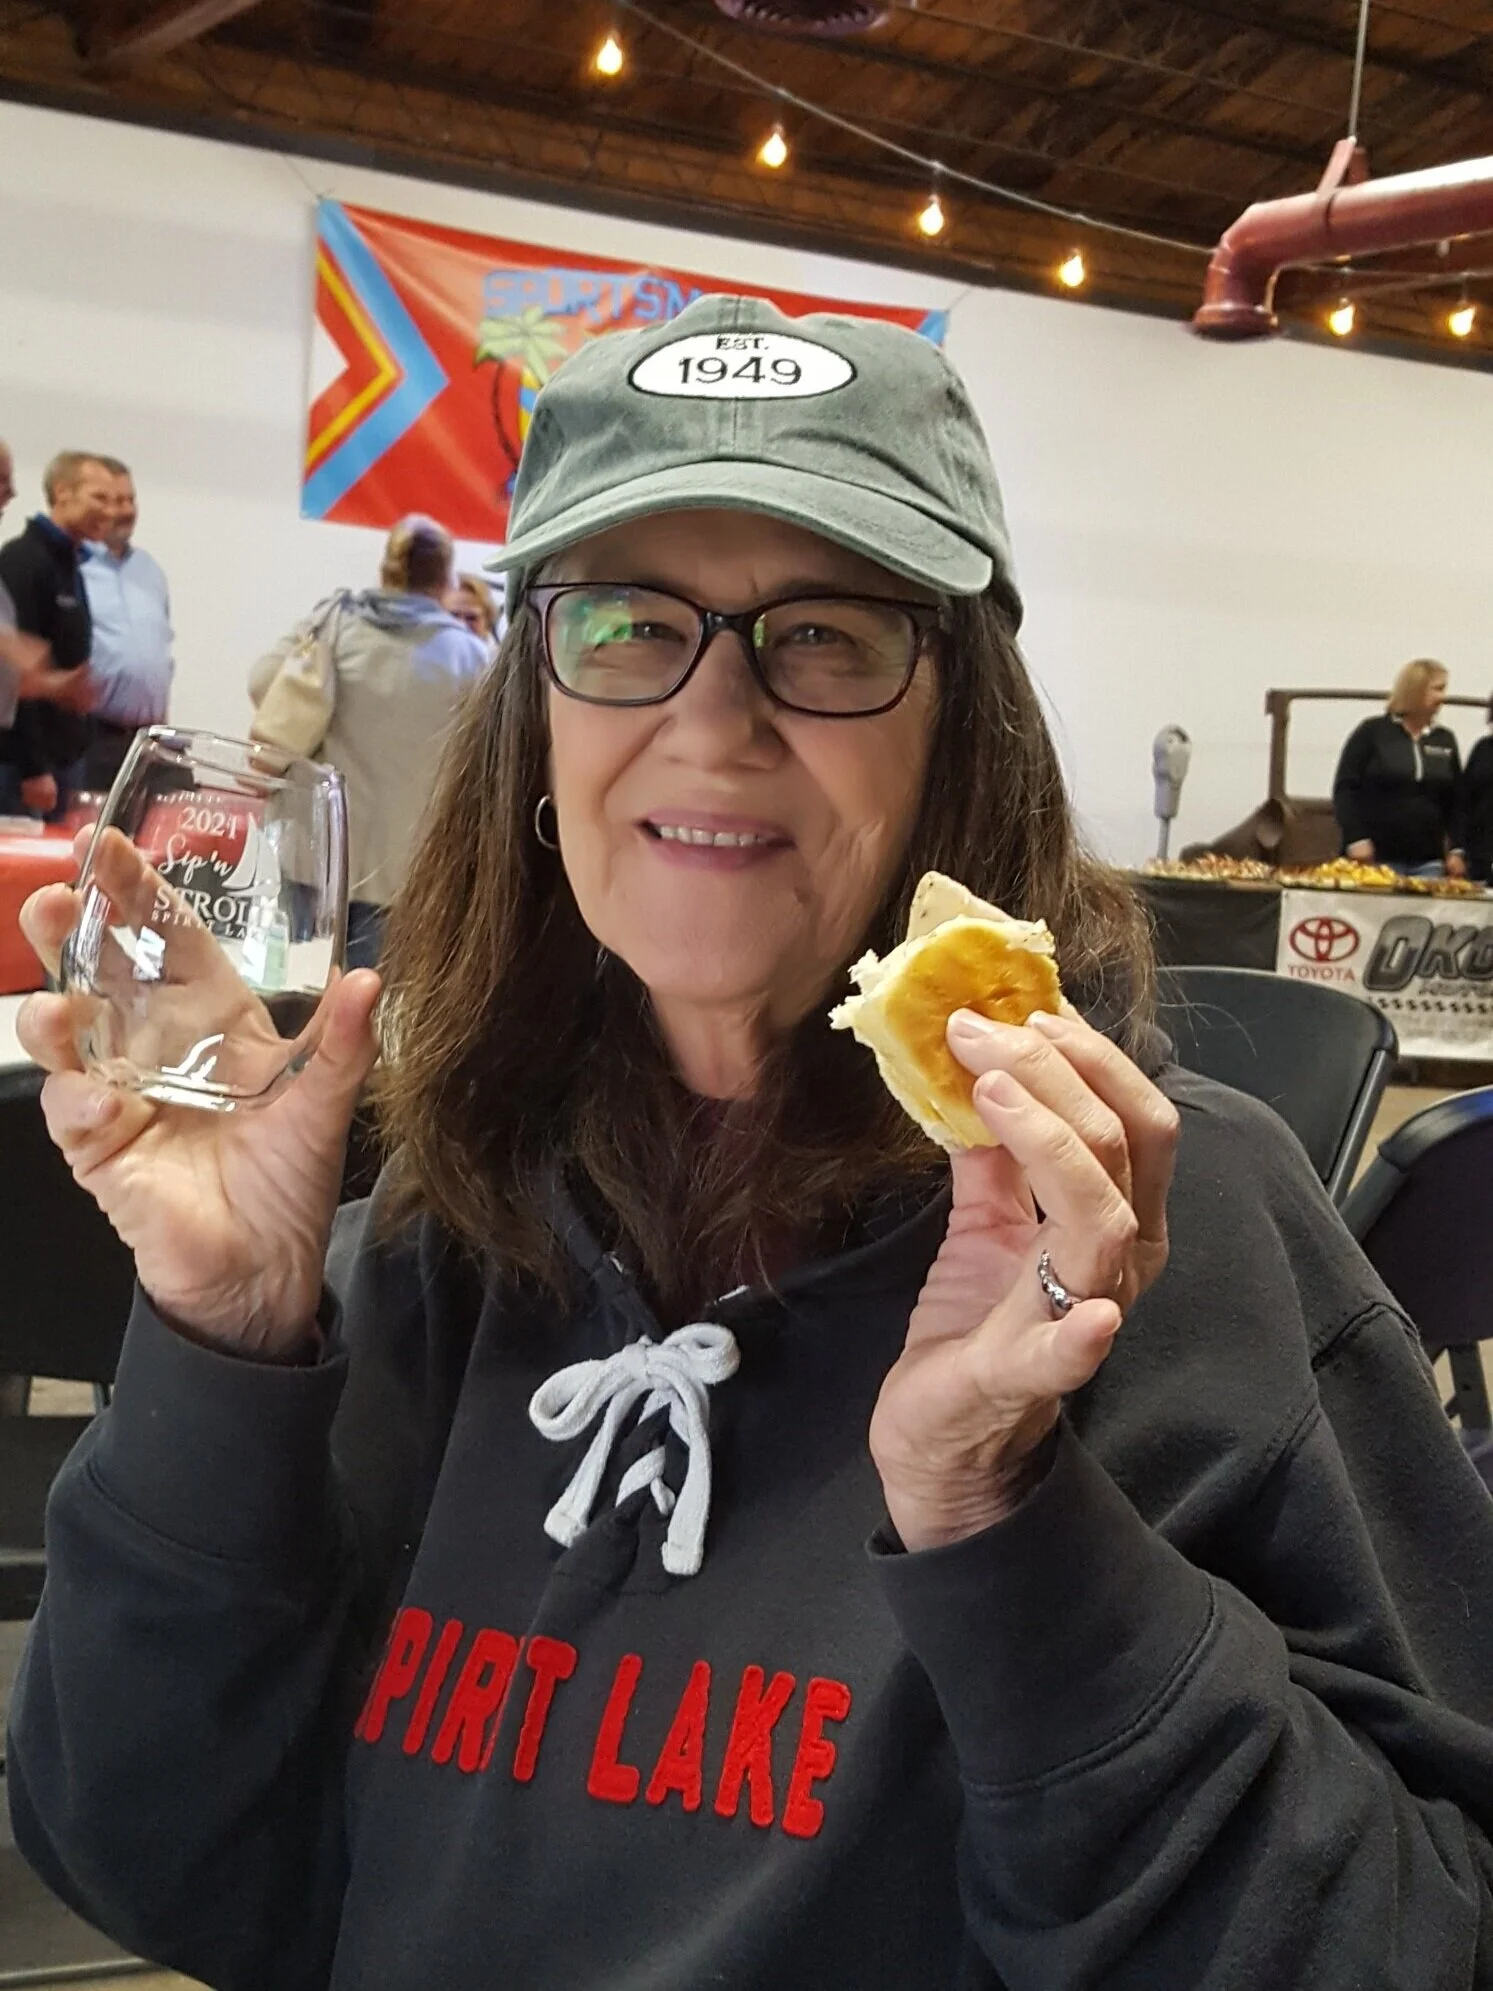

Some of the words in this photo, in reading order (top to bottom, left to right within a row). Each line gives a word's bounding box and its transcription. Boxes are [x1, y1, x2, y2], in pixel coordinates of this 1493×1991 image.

[484, 265, 704, 325] SPORTSM
[715, 336, 769, 350] EST.
[679, 356, 802, 385] 1949
[180, 806, 238, 840] 2021
[1288, 965, 1356, 983] TOYOTA
[586, 1653, 852, 1839] LAKE
